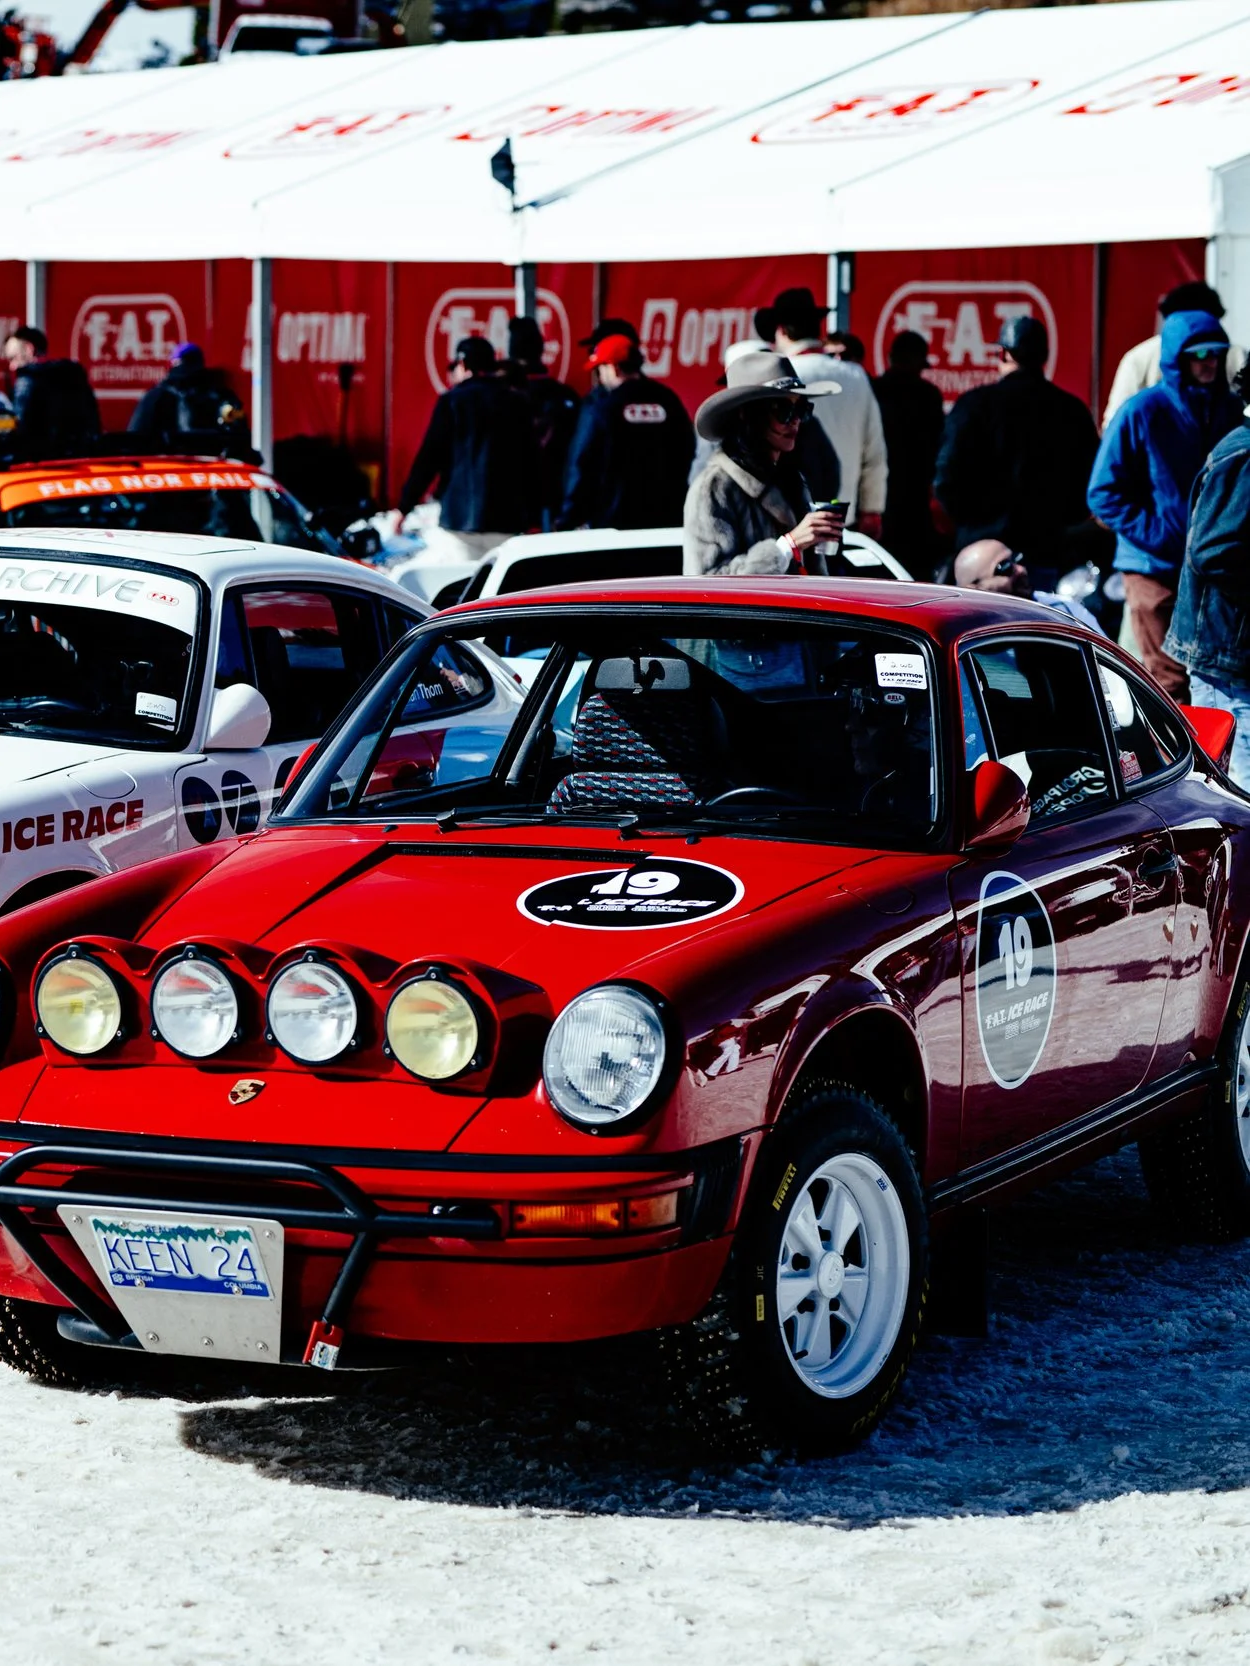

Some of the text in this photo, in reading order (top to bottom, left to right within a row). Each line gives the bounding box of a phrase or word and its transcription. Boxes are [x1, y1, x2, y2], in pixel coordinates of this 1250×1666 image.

[880, 671, 924, 679] COMPETITION
[137, 709, 174, 721] COMPETITION
[2, 814, 55, 854] ICE
[62, 799, 145, 843] RACE
[589, 871, 681, 896] 19
[998, 915, 1033, 991] 19
[1022, 991, 1049, 1016] RACE
[103, 1236, 258, 1281] KEEN 24
